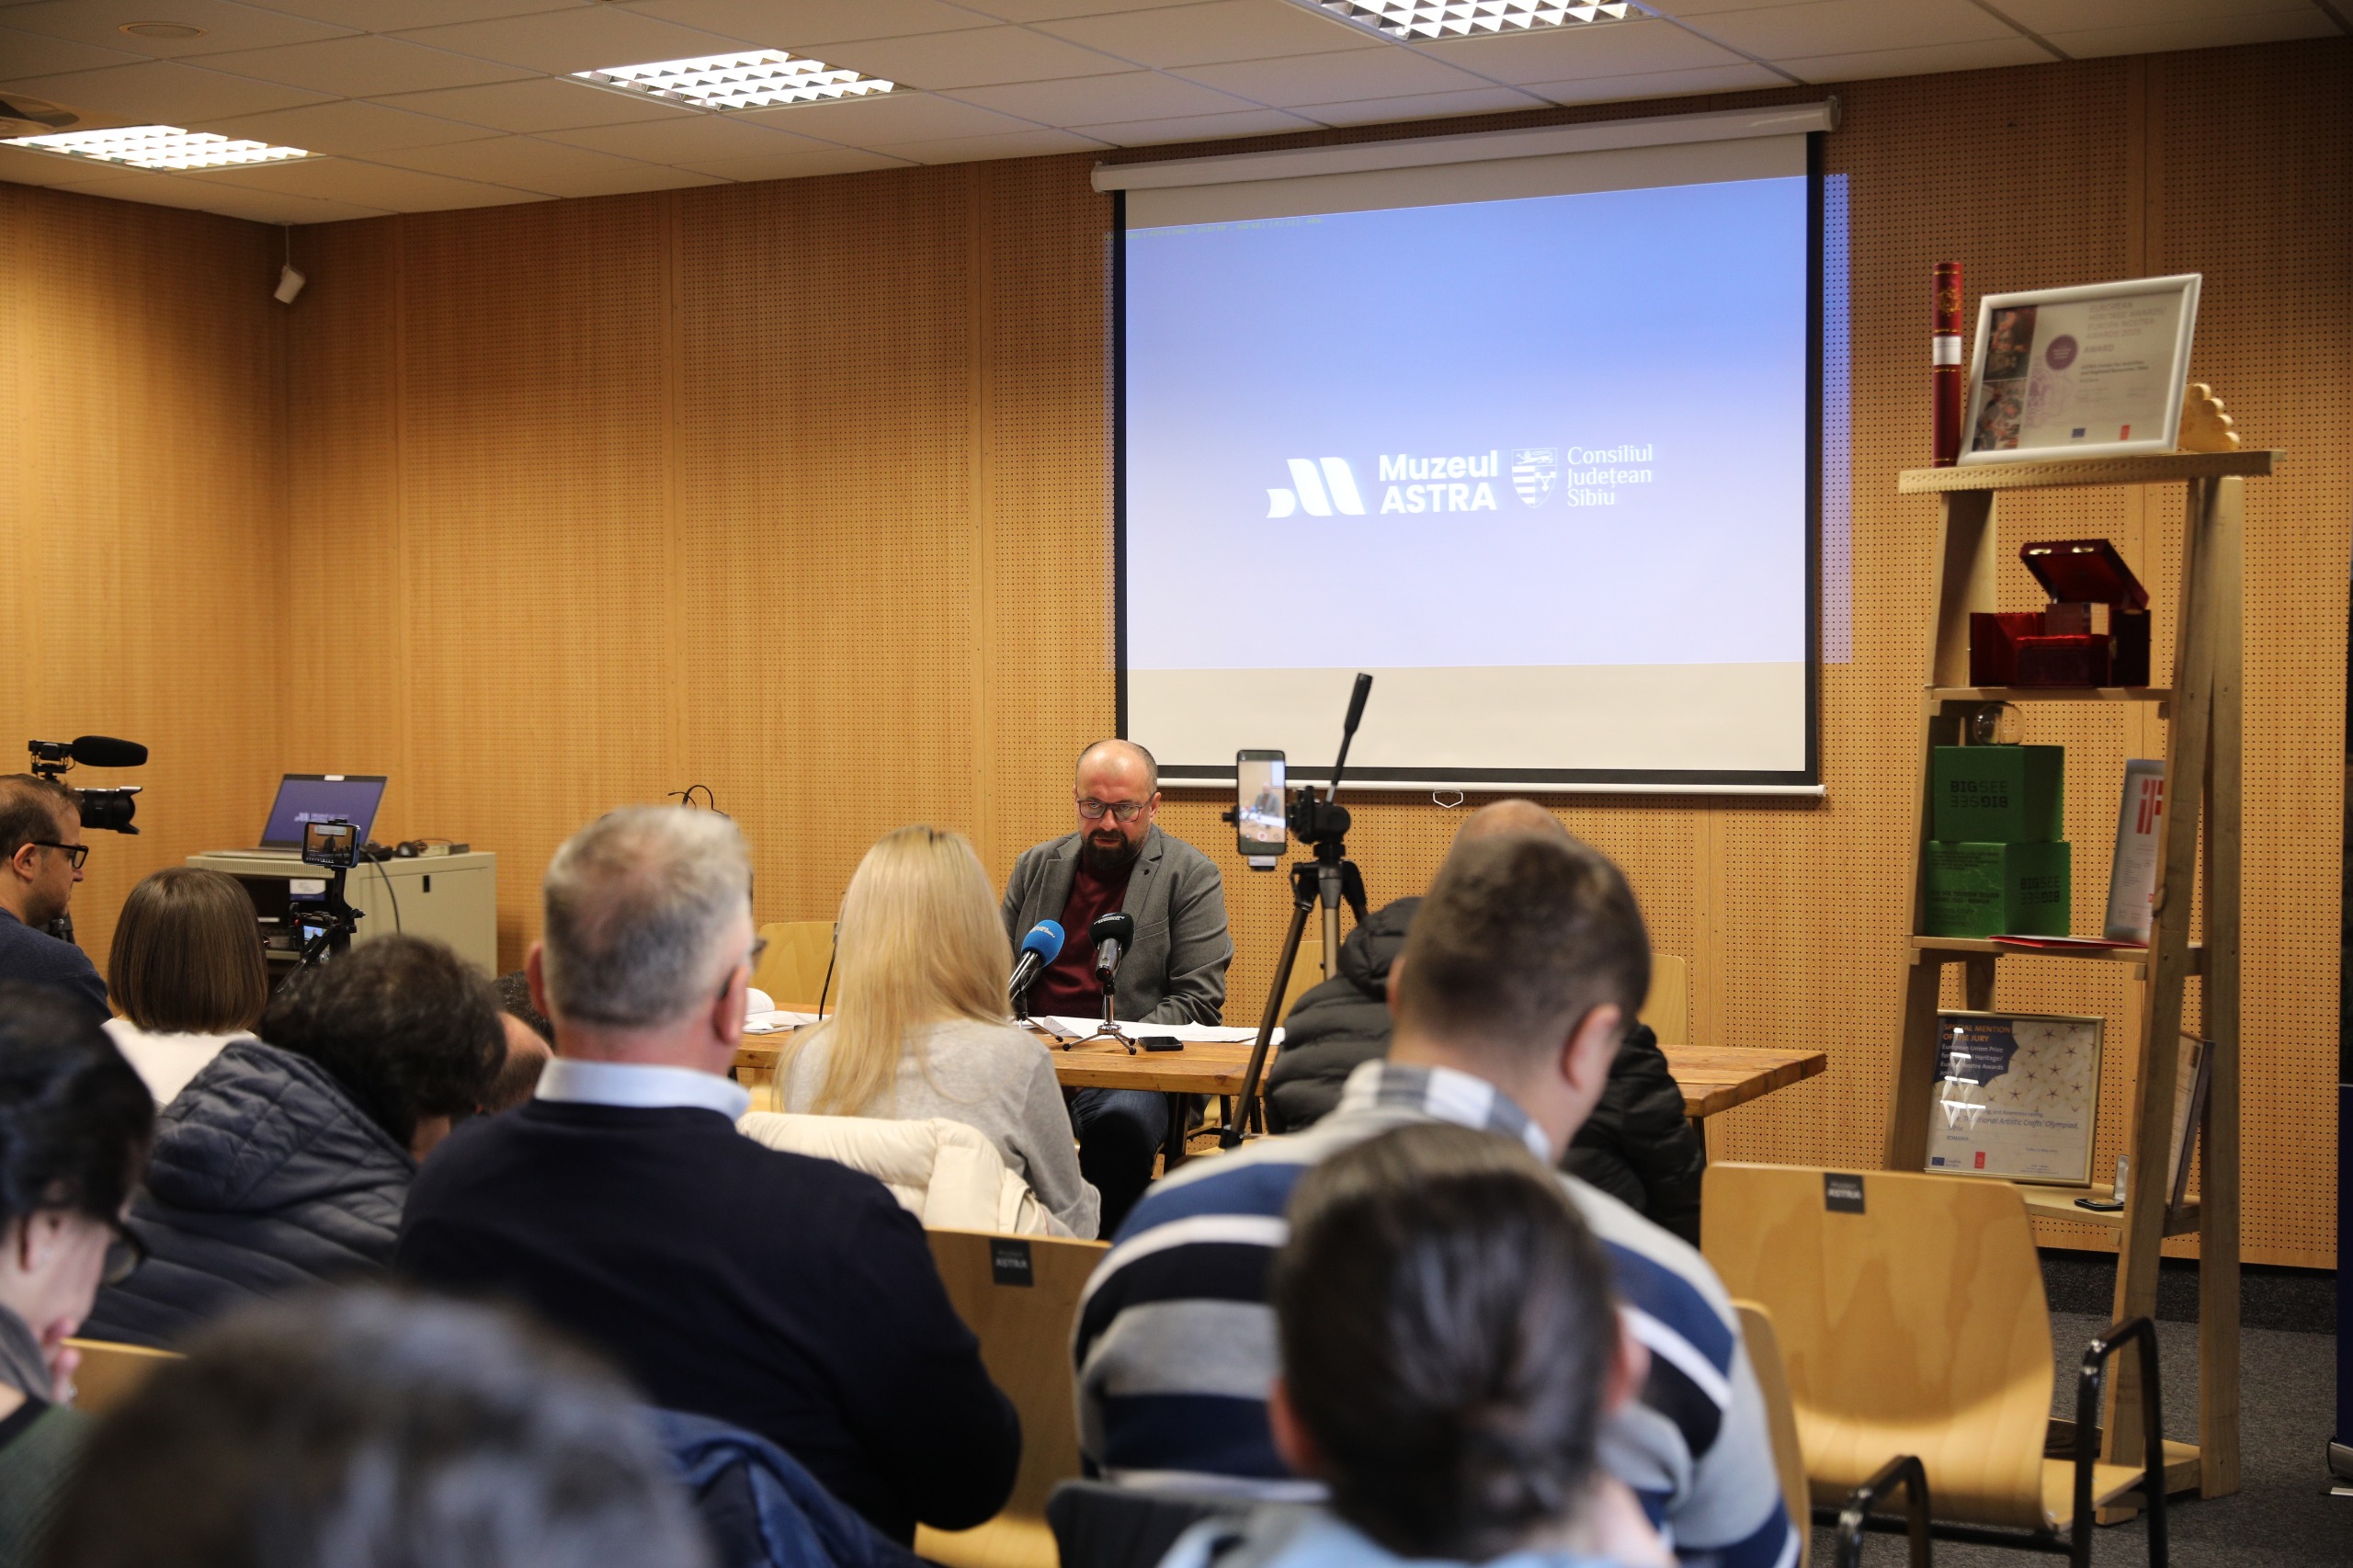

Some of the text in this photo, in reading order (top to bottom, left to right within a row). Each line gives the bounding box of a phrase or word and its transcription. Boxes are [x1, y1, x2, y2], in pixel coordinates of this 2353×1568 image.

[1566, 444, 1654, 465] Consiliul
[1379, 449, 1498, 482] Muzeul
[1566, 467, 1653, 489] Județean
[1380, 483, 1498, 515] ASTRA
[1566, 488, 1616, 507] Sibiu
[1974, 1026, 2011, 1034] MENTION
[1998, 1118, 2022, 1126] Artistic
